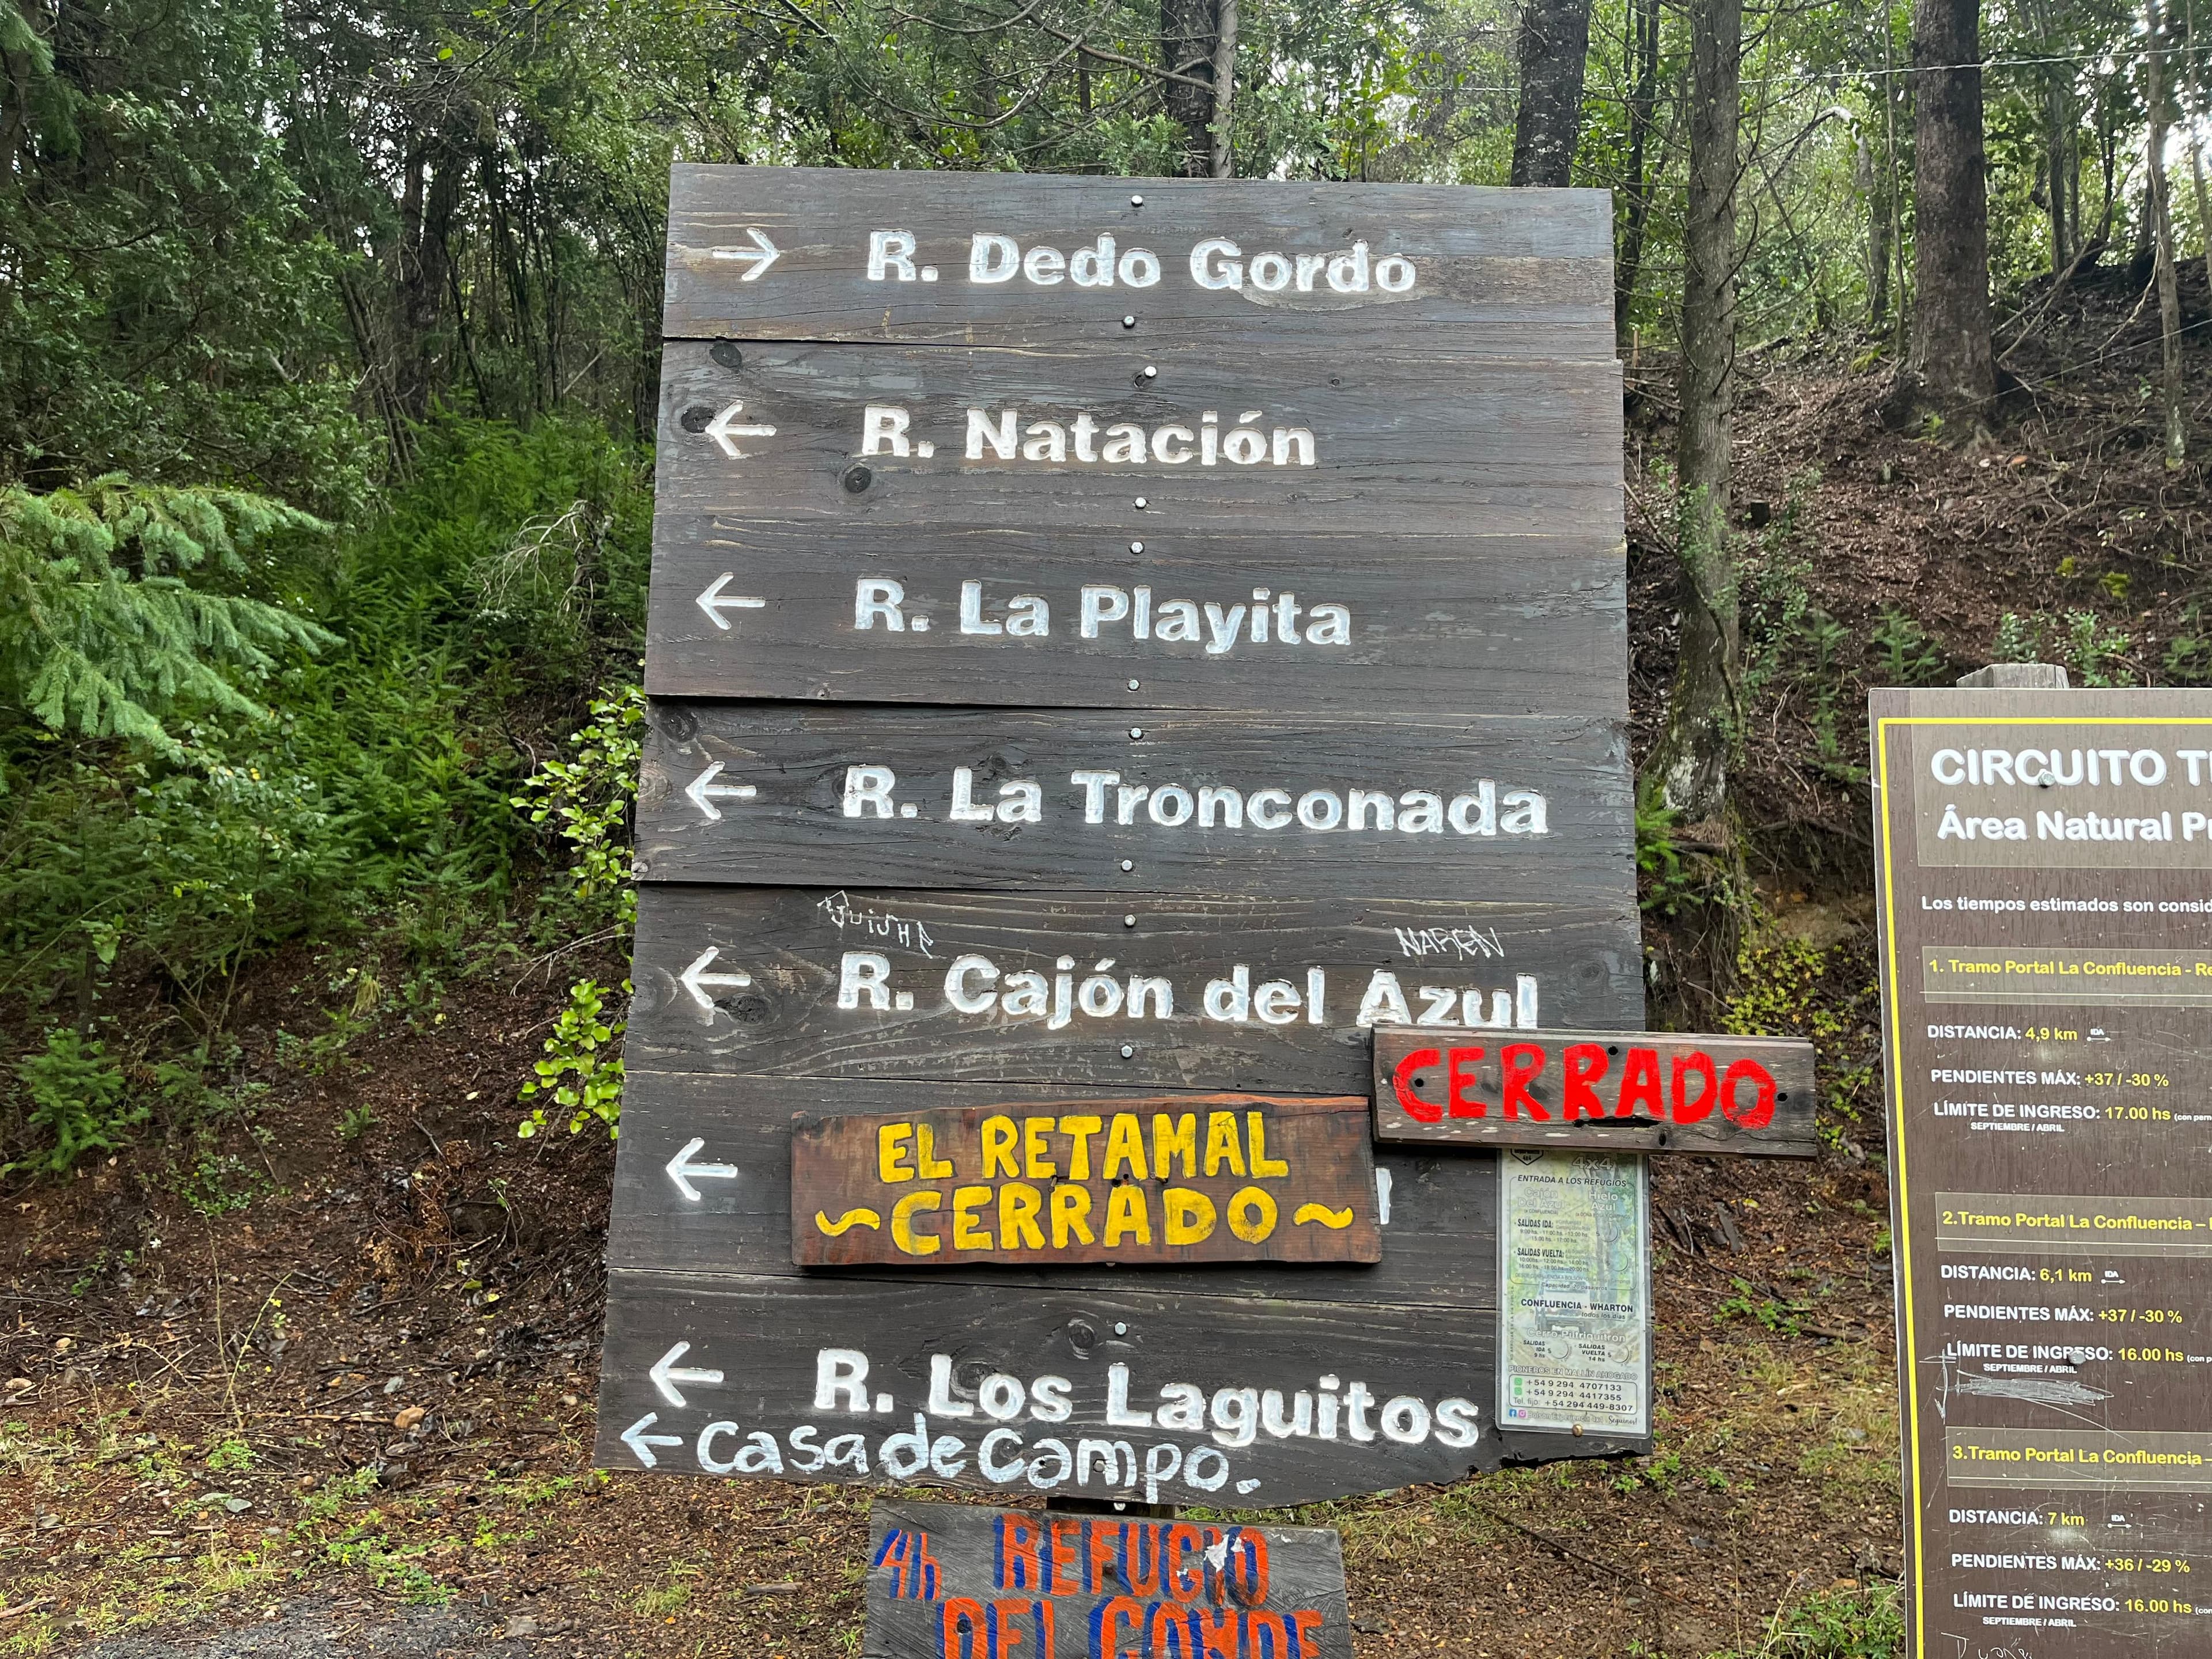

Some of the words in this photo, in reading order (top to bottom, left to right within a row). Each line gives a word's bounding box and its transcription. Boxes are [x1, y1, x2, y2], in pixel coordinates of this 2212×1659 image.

[867, 228, 938, 282] R.
[969, 232, 1162, 289] Dedo
[1189, 236, 1416, 293] Gordo
[862, 404, 934, 459] R.
[967, 408, 1316, 467] Natación
[854, 577, 929, 632] R.
[960, 579, 1050, 637] La
[1080, 584, 1351, 655] Playita
[1931, 749, 2166, 786] CIRCUITO
[843, 764, 918, 819] R.
[949, 766, 1041, 824] La
[1071, 769, 1548, 837] Tronconada
[1937, 804, 2027, 839] Área
[2036, 810, 2172, 840] Natural
[1922, 896, 1952, 910] Los
[1957, 897, 2025, 913] tiempos
[2030, 898, 2118, 911] estimados
[2123, 902, 2153, 912] son
[1929, 960, 1944, 972] 1.
[1949, 960, 2001, 973] Tramo
[2005, 961, 2054, 974] Portal
[2059, 961, 2079, 975] La
[2084, 962, 2181, 975] Confluencia
[836, 950, 913, 1011] R.
[944, 953, 1173, 1030] Cajón
[1203, 963, 1325, 1024] del
[1356, 967, 1538, 1029] Azul
[1927, 1025, 2021, 1040] DISTANCIA:
[2025, 1027, 2050, 1043] 4,9
[2054, 1028, 2078, 1040] km
[1393, 1044, 1777, 1130] CERRADO
[1931, 1069, 2036, 1085] PENDIENTES
[2041, 1069, 2081, 1086] MÁX:
[2085, 1073, 2113, 1086] +37
[2126, 1074, 2150, 1086] -30
[2154, 1074, 2169, 1087] %
[1934, 1101, 1988, 1118] LÍMITE
[1993, 1104, 2015, 1118] DE
[2020, 1104, 2101, 1119] INGRESO:
[2104, 1106, 2148, 1120] 17.00
[2152, 1107, 2171, 1121] hs
[1971, 1123, 2030, 1131] SEPTIEMBRE
[2036, 1123, 2065, 1132] ABRIL
[878, 1121, 954, 1184] EL
[982, 1110, 1288, 1182] RETAMAL
[1572, 1156, 1614, 1171] 4x4
[1584, 1179, 1626, 1187] REFUGIOS
[1524, 1187, 1558, 1199] Cajón
[1588, 1191, 1618, 1201] Hielo
[1540, 1199, 1565, 1209] Azul
[1591, 1201, 1616, 1211] Azul
[891, 1181, 1277, 1255] CERRADO
[1518, 1218, 1540, 1227] SALIDAS
[1542, 1219, 1553, 1228] IDA:
[1943, 1211, 2011, 1226] 2.Tramo
[2016, 1213, 2065, 1228] Portal
[2070, 1214, 2090, 1228] La
[2094, 1215, 2192, 1230] Confluencia
[1517, 1248, 1540, 1256] SALIDAS
[1542, 1249, 1564, 1257] VUELTA:
[1941, 1264, 2036, 1281] DISTANCIA:
[2040, 1268, 2063, 1283] 6,1
[2069, 1269, 2092, 1282] km
[1521, 1299, 1581, 1309] CONFLUENCIA
[1590, 1303, 1633, 1312] WHARTON
[1944, 1304, 2050, 1321] PENDIENTES
[2055, 1305, 2094, 1322] MÁX:
[2099, 1309, 2126, 1322] +37
[2139, 1309, 2164, 1323] -30
[2167, 1310, 2182, 1323] %
[1947, 1340, 2002, 1358] LÍMITE
[2006, 1344, 2028, 1358] DE
[2118, 1348, 2160, 1361] 16.00
[2165, 1349, 2183, 1361] hs
[1509, 1365, 1550, 1374] PIONEROS
[1565, 1368, 1594, 1377] MALLÍN
[1597, 1372, 1637, 1380] AHOGADO
[1984, 1363, 2043, 1373] SEPTIEMBRE
[2050, 1364, 2077, 1373] ABRIL
[1580, 1382, 1622, 1391] 4707133
[815, 1348, 893, 1414] R.
[930, 1353, 1072, 1423] Los
[1107, 1362, 1479, 1449] Laguitos
[1580, 1392, 1622, 1400] 4417355
[1587, 1403, 1633, 1411] 449-8307
[696, 1420, 869, 1475] Casa
[878, 1412, 967, 1480] de
[977, 1427, 1262, 1504] Campo.
[1953, 1446, 2021, 1461] 3.Tramo
[2025, 1448, 2074, 1462] Portal
[2079, 1449, 2099, 1463] La
[2103, 1450, 2202, 1465] Confluencia
[1949, 1510, 2043, 1525] DISTANCIA:
[2048, 1512, 2056, 1525] 7
[2061, 1513, 2084, 1526] km
[993, 1513, 1268, 1606] REFUGIO
[1952, 1554, 2056, 1570] PENDIENTES
[2062, 1554, 2101, 1571] MÁX:
[2105, 1558, 2134, 1571] +36
[2146, 1559, 2172, 1572] -29
[2175, 1560, 2190, 1573] %
[1954, 1591, 2008, 1608] LÍMITE
[2012, 1594, 2034, 1609] DE
[2039, 1596, 2120, 1611] INGRESO:
[2125, 1599, 2169, 1612] 16.00
[2173, 1599, 2192, 1613] hs
[1983, 1616, 2042, 1626] SEPTIEMBRE
[2048, 1617, 2076, 1627] ABRIL
